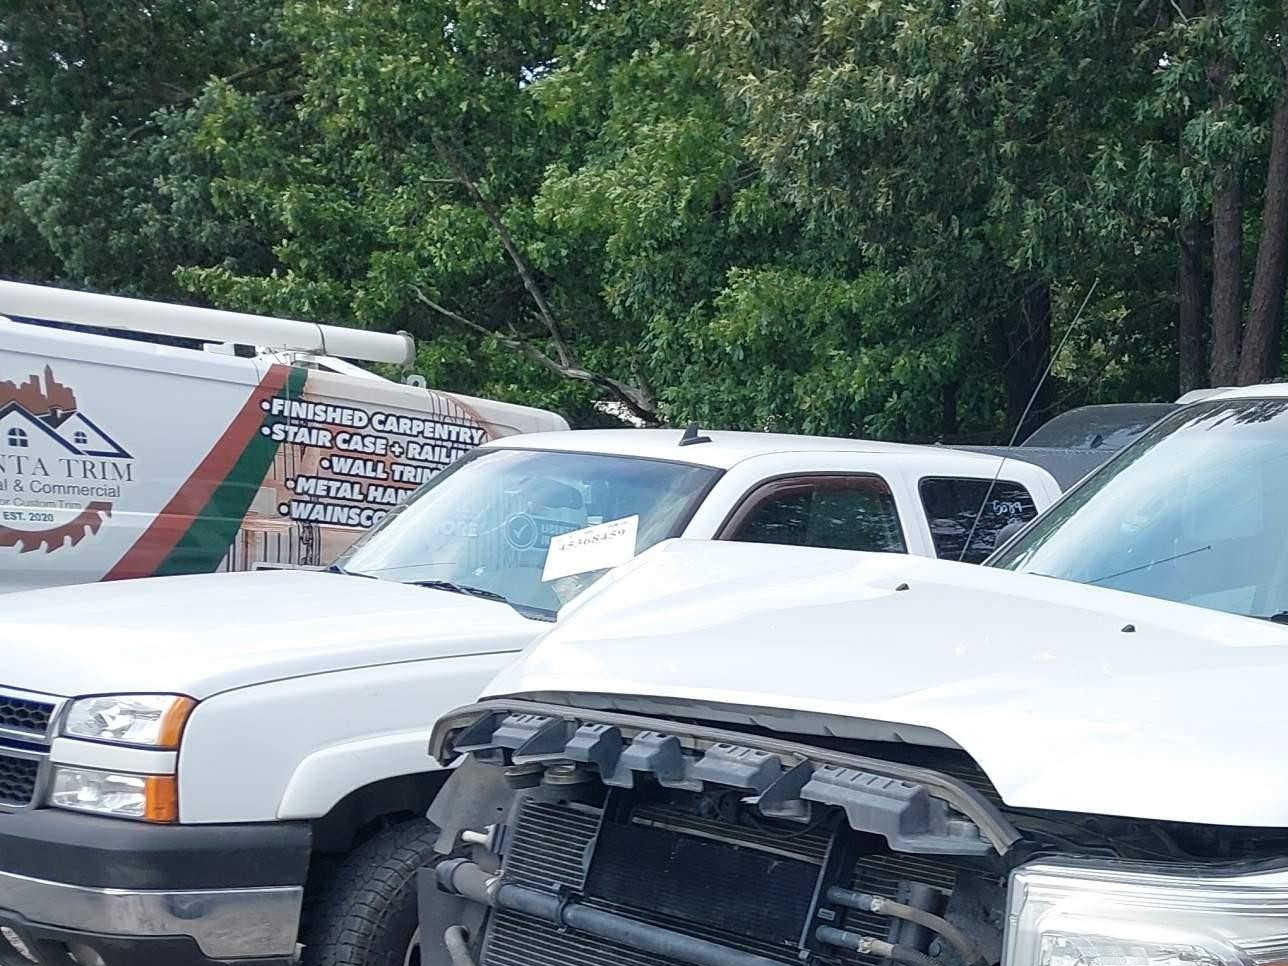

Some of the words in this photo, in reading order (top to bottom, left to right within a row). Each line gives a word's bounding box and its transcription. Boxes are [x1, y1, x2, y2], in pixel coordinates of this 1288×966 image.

[271, 399, 369, 428] FINISHED
[371, 412, 486, 445] CARPENTRY
[271, 424, 332, 448] STAIR
[335, 432, 387, 455] CASE
[59, 459, 135, 482] TRIM
[330, 457, 388, 479] WALL
[13, 479, 24, 492] &
[30, 480, 121, 498] Commercial
[296, 477, 363, 501] METAL
[3, 511, 26, 521] EST.
[29, 512, 54, 522] 2020
